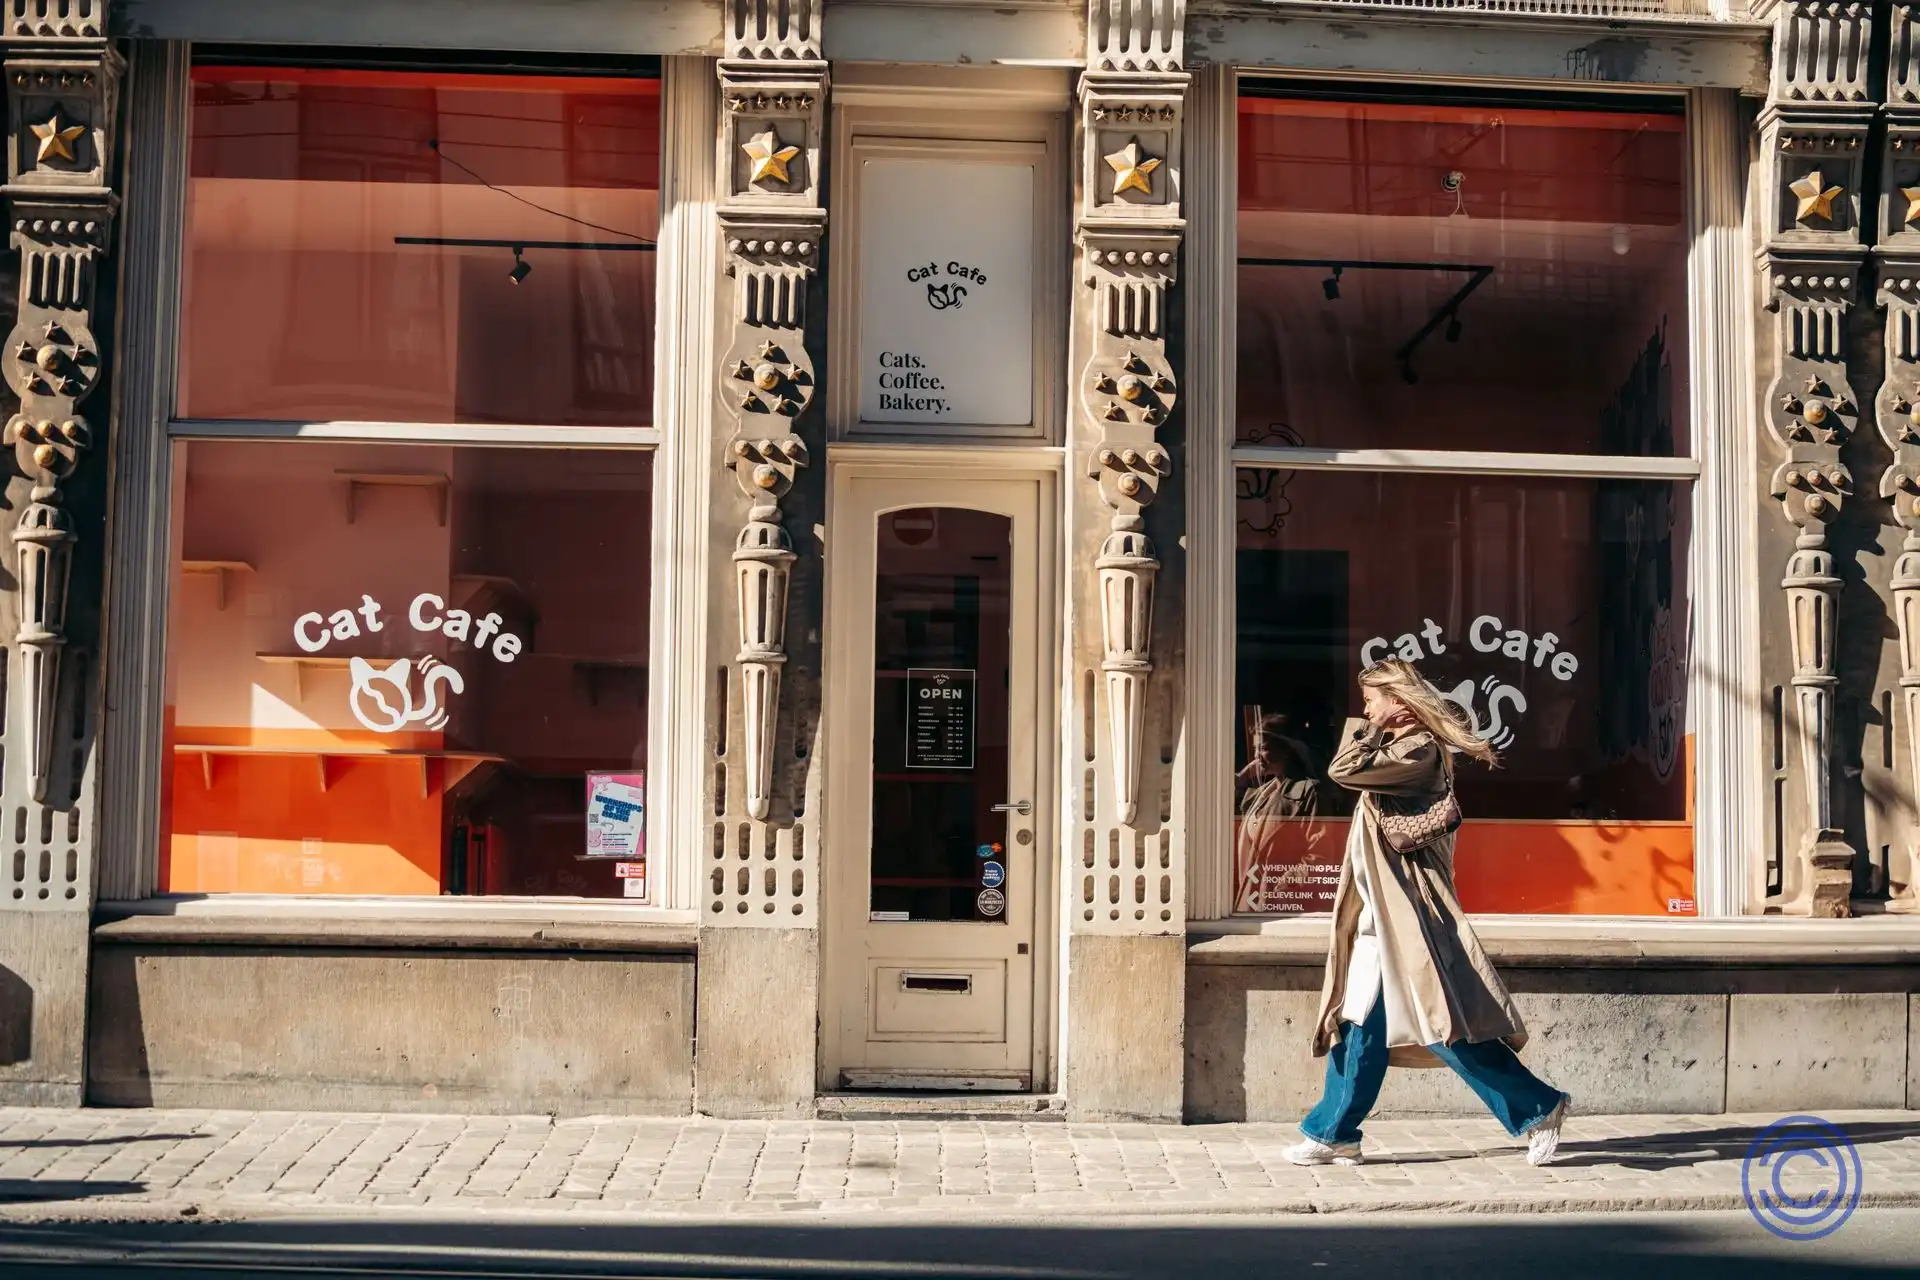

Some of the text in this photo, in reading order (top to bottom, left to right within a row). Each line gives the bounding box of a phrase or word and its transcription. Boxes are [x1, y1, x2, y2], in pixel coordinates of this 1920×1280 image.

[907, 261, 987, 285] Cat Cafe
[879, 352, 926, 369] Cats.
[879, 372, 945, 390] Coffee.
[879, 393, 951, 415] Bakery.
[293, 593, 522, 662] Cat Cafe
[1360, 618, 1447, 670] Cat
[1469, 615, 1579, 681] Cafe
[920, 688, 962, 699] OPEN
[1262, 864, 1287, 872] WHEN
[1262, 876, 1286, 884] FROM
[1287, 876, 1303, 884] THE
[1262, 903, 1305, 911] SCHUIVEN.
